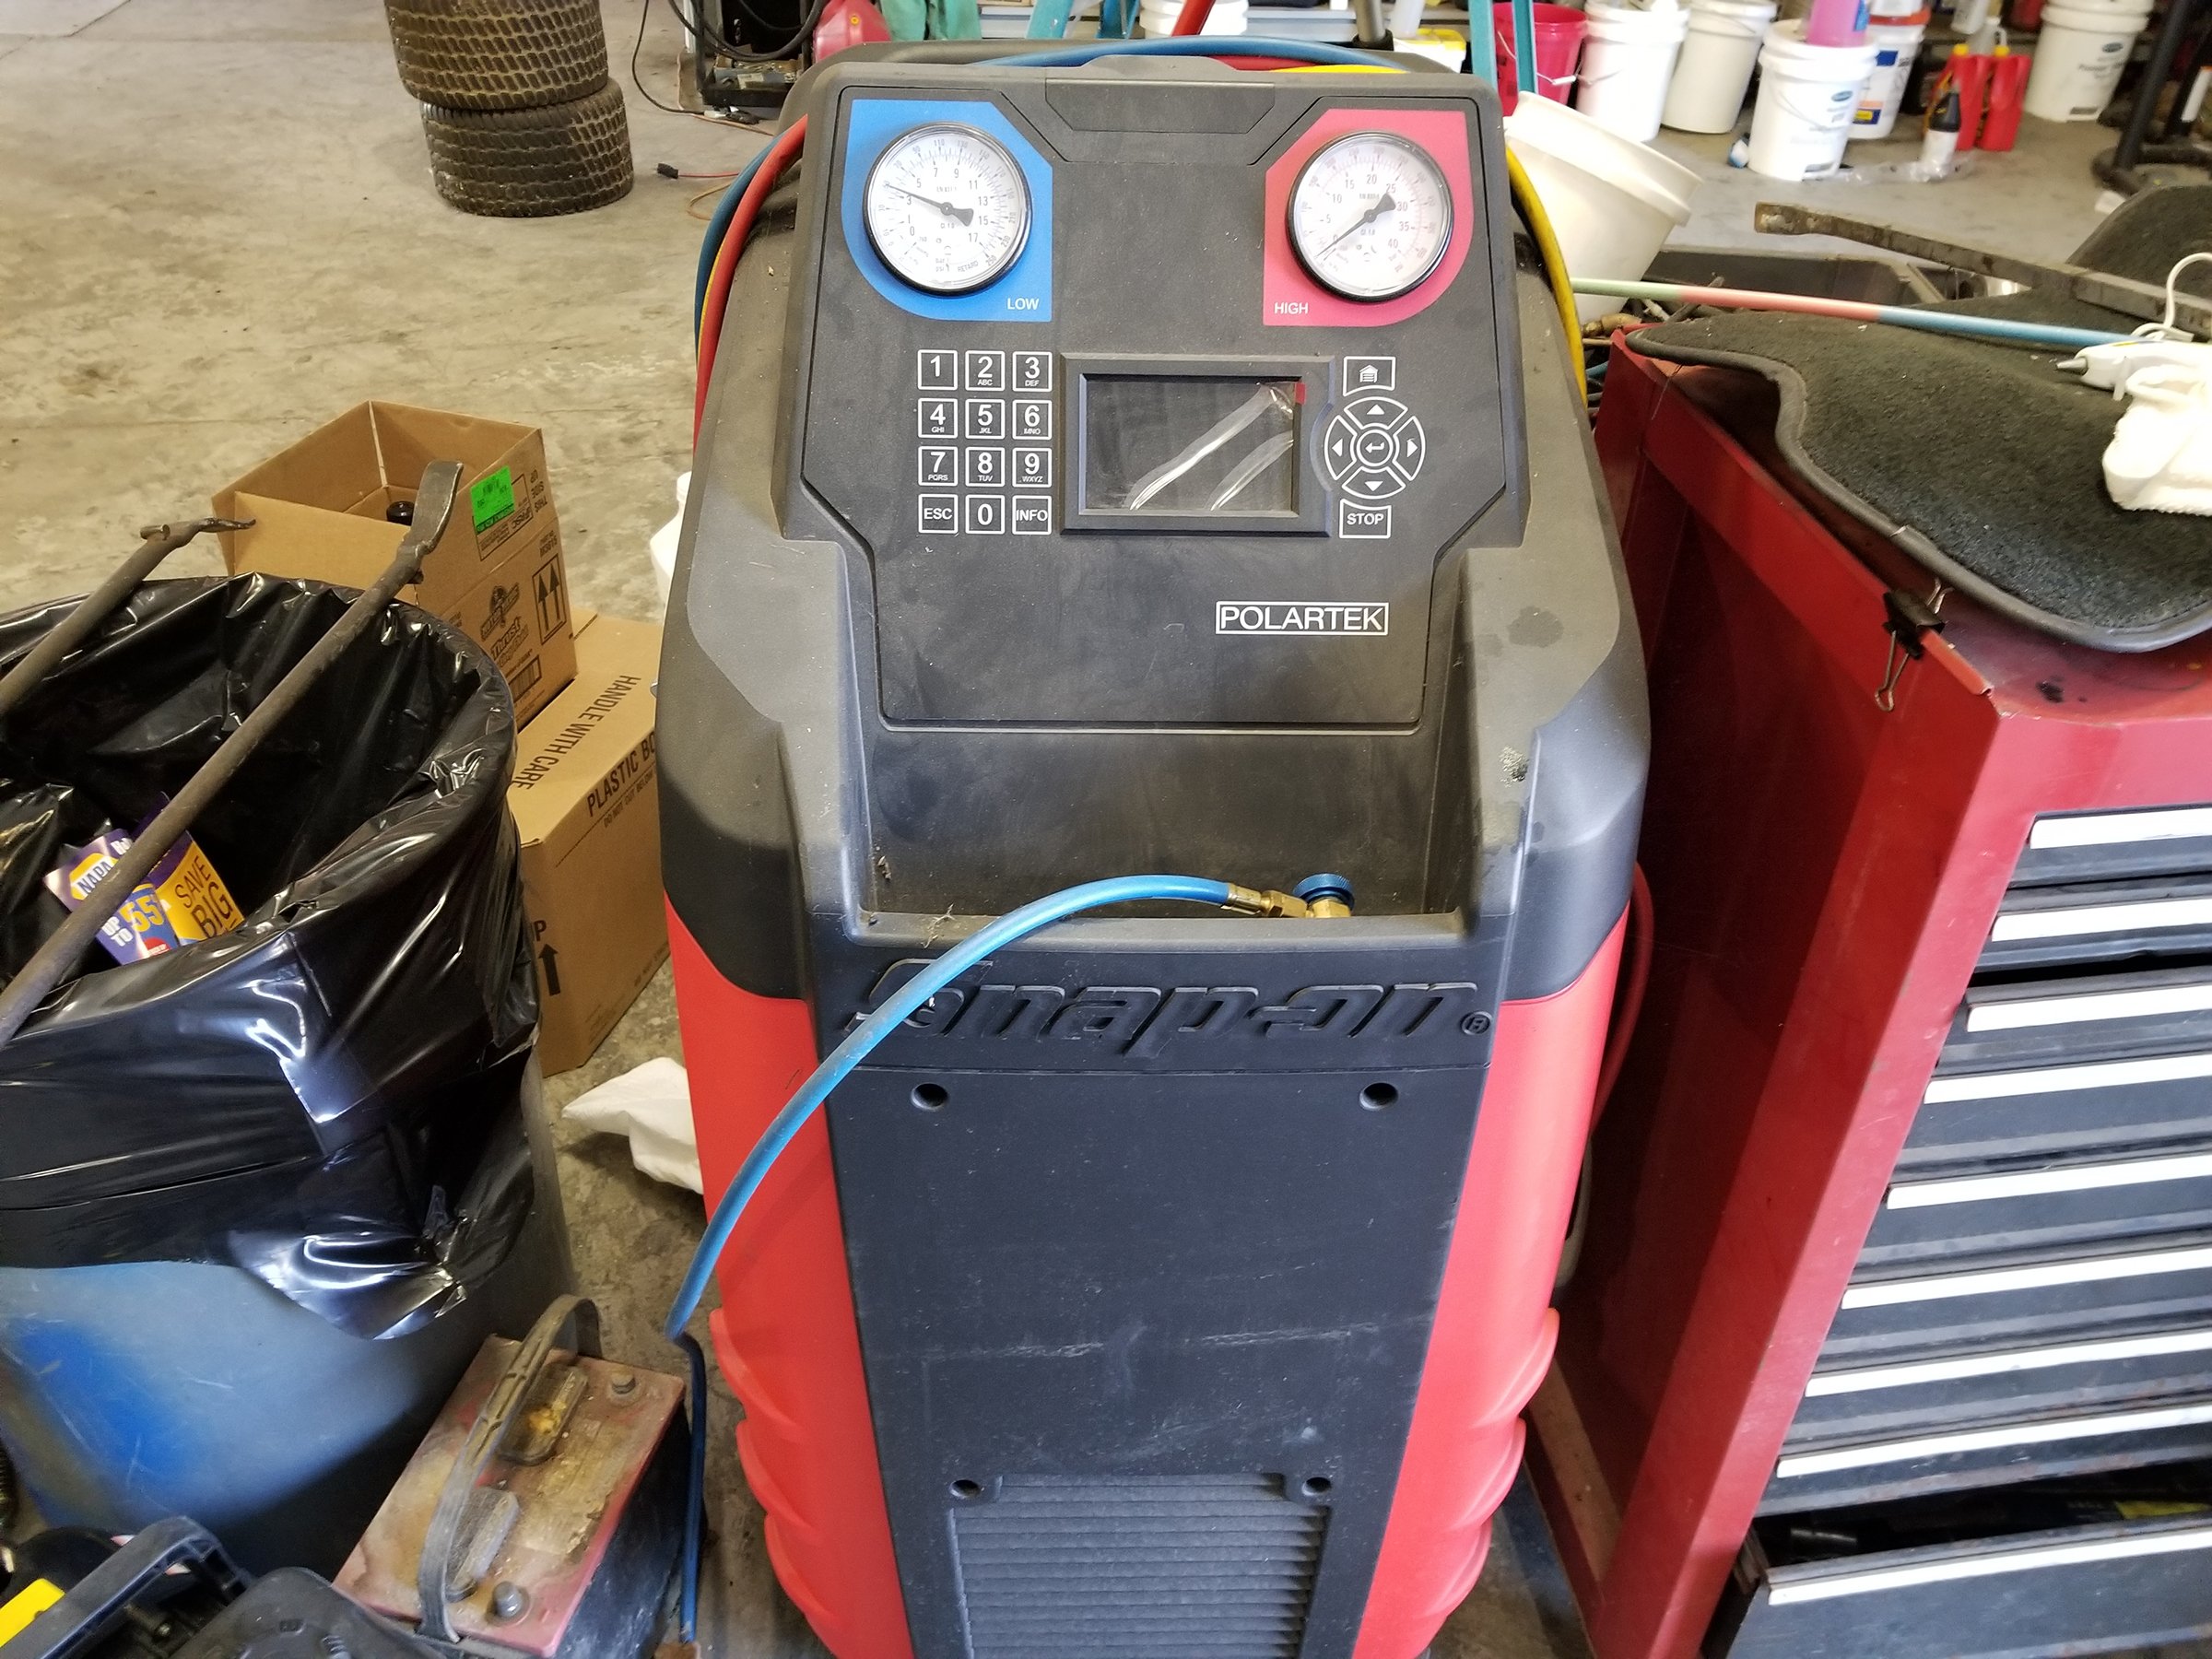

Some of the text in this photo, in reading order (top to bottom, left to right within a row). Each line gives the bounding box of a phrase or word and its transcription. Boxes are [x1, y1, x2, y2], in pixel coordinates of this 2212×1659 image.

[933, 167, 938, 177] 7
[953, 168, 959, 179] 9
[916, 178, 922, 188] 5
[969, 180, 978, 190] 11
[1345, 179, 1355, 190] 15
[1366, 173, 1378, 185] 20
[1386, 182, 1396, 194] 25
[906, 194, 912, 206] 3
[978, 195, 988, 206] 13
[1333, 193, 1343, 204] 10
[1396, 200, 1408, 212] 30
[979, 215, 989, 226] 15
[1326, 213, 1332, 224] 5
[910, 226, 915, 236] 0
[1398, 220, 1409, 231] 35
[969, 232, 978, 242] 17
[1388, 238, 1399, 249] 40
[1006, 298, 1040, 311] LOW
[1274, 302, 1309, 314] HIGH
[930, 355, 940, 377] 1
[977, 356, 993, 378] 2
[1025, 357, 1040, 379] 3
[929, 404, 947, 425] 4
[977, 404, 993, 426] 5
[1024, 405, 1041, 428] 6
[930, 451, 947, 473] 7
[977, 452, 993, 474] 8
[1024, 453, 1041, 476] 9
[924, 508, 953, 520] ESC
[977, 503, 993, 525] 0
[1016, 509, 1048, 522] INFO
[1347, 512, 1384, 525] STOP
[1220, 606, 1383, 630] POLARTEK
[578, 675, 641, 722] HANDLE
[544, 724, 595, 754] WITH
[512, 756, 559, 790] CARE
[587, 750, 639, 818] PLASTIC
[77, 861, 112, 896] NAPA
[176, 855, 211, 908] SAVE
[119, 894, 164, 933] 55
[192, 881, 234, 938] BIG
[101, 916, 122, 936] UP
[111, 927, 134, 947] TO
